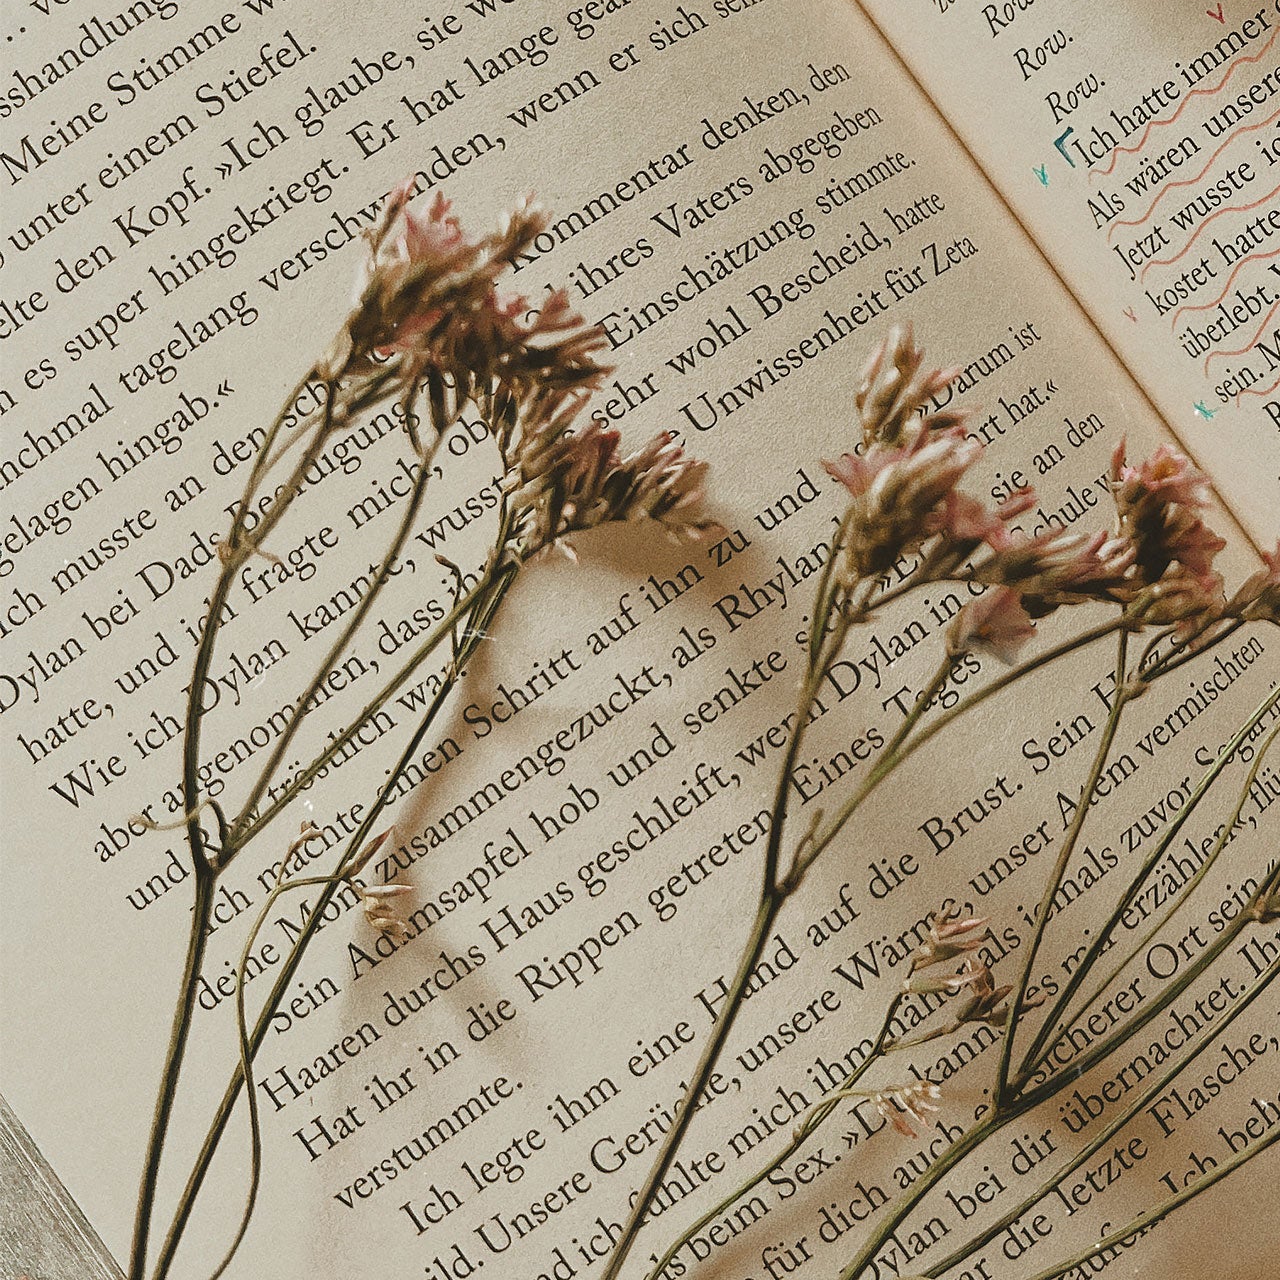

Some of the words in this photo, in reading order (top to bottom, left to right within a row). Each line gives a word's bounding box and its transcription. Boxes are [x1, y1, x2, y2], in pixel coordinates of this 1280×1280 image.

[106, 13, 242, 107] Stimme
[195, 29, 317, 118] Stiefel.
[1012, 29, 1074, 82] Row.
[1044, 73, 1106, 125] Row.
[111, 165, 212, 249] Kopf.
[294, 50, 416, 138] glaube,
[147, 158, 350, 297] hingekriegt.
[462, 26, 560, 88] lange
[700, 87, 811, 151] denken,
[649, 176, 754, 239] Vaters
[758, 107, 884, 184] abgegeben
[815, 152, 917, 215] stimmte.
[664, 304, 752, 376] wohl
[745, 220, 892, 321] Bescheid,
[882, 193, 946, 236] hatte
[118, 290, 259, 394] tagelang
[677, 290, 890, 432] Unwissenheit
[920, 237, 979, 277] Zeta
[95, 379, 235, 483] hingab.«
[50, 509, 158, 596] musste
[16, 698, 114, 765] hatte,
[461, 649, 582, 740] Schritt
[682, 650, 788, 736] senkte
[372, 665, 673, 887] zusammengezuckt,
[257, 1022, 383, 1113] Haaren
[478, 881, 575, 954] Haus
[577, 762, 741, 898] geschleift,
[460, 1129, 547, 1194] legte
[916, 776, 1024, 857] Brust.
[1021, 714, 1097, 776] Sein
[514, 911, 643, 1004] Rippen
[1145, 1033, 1280, 1140] Flasche,
[333, 1077, 524, 1209] verstummte.
[1010, 1128, 1059, 1176] dir
[472, 1172, 592, 1254] Unsere
